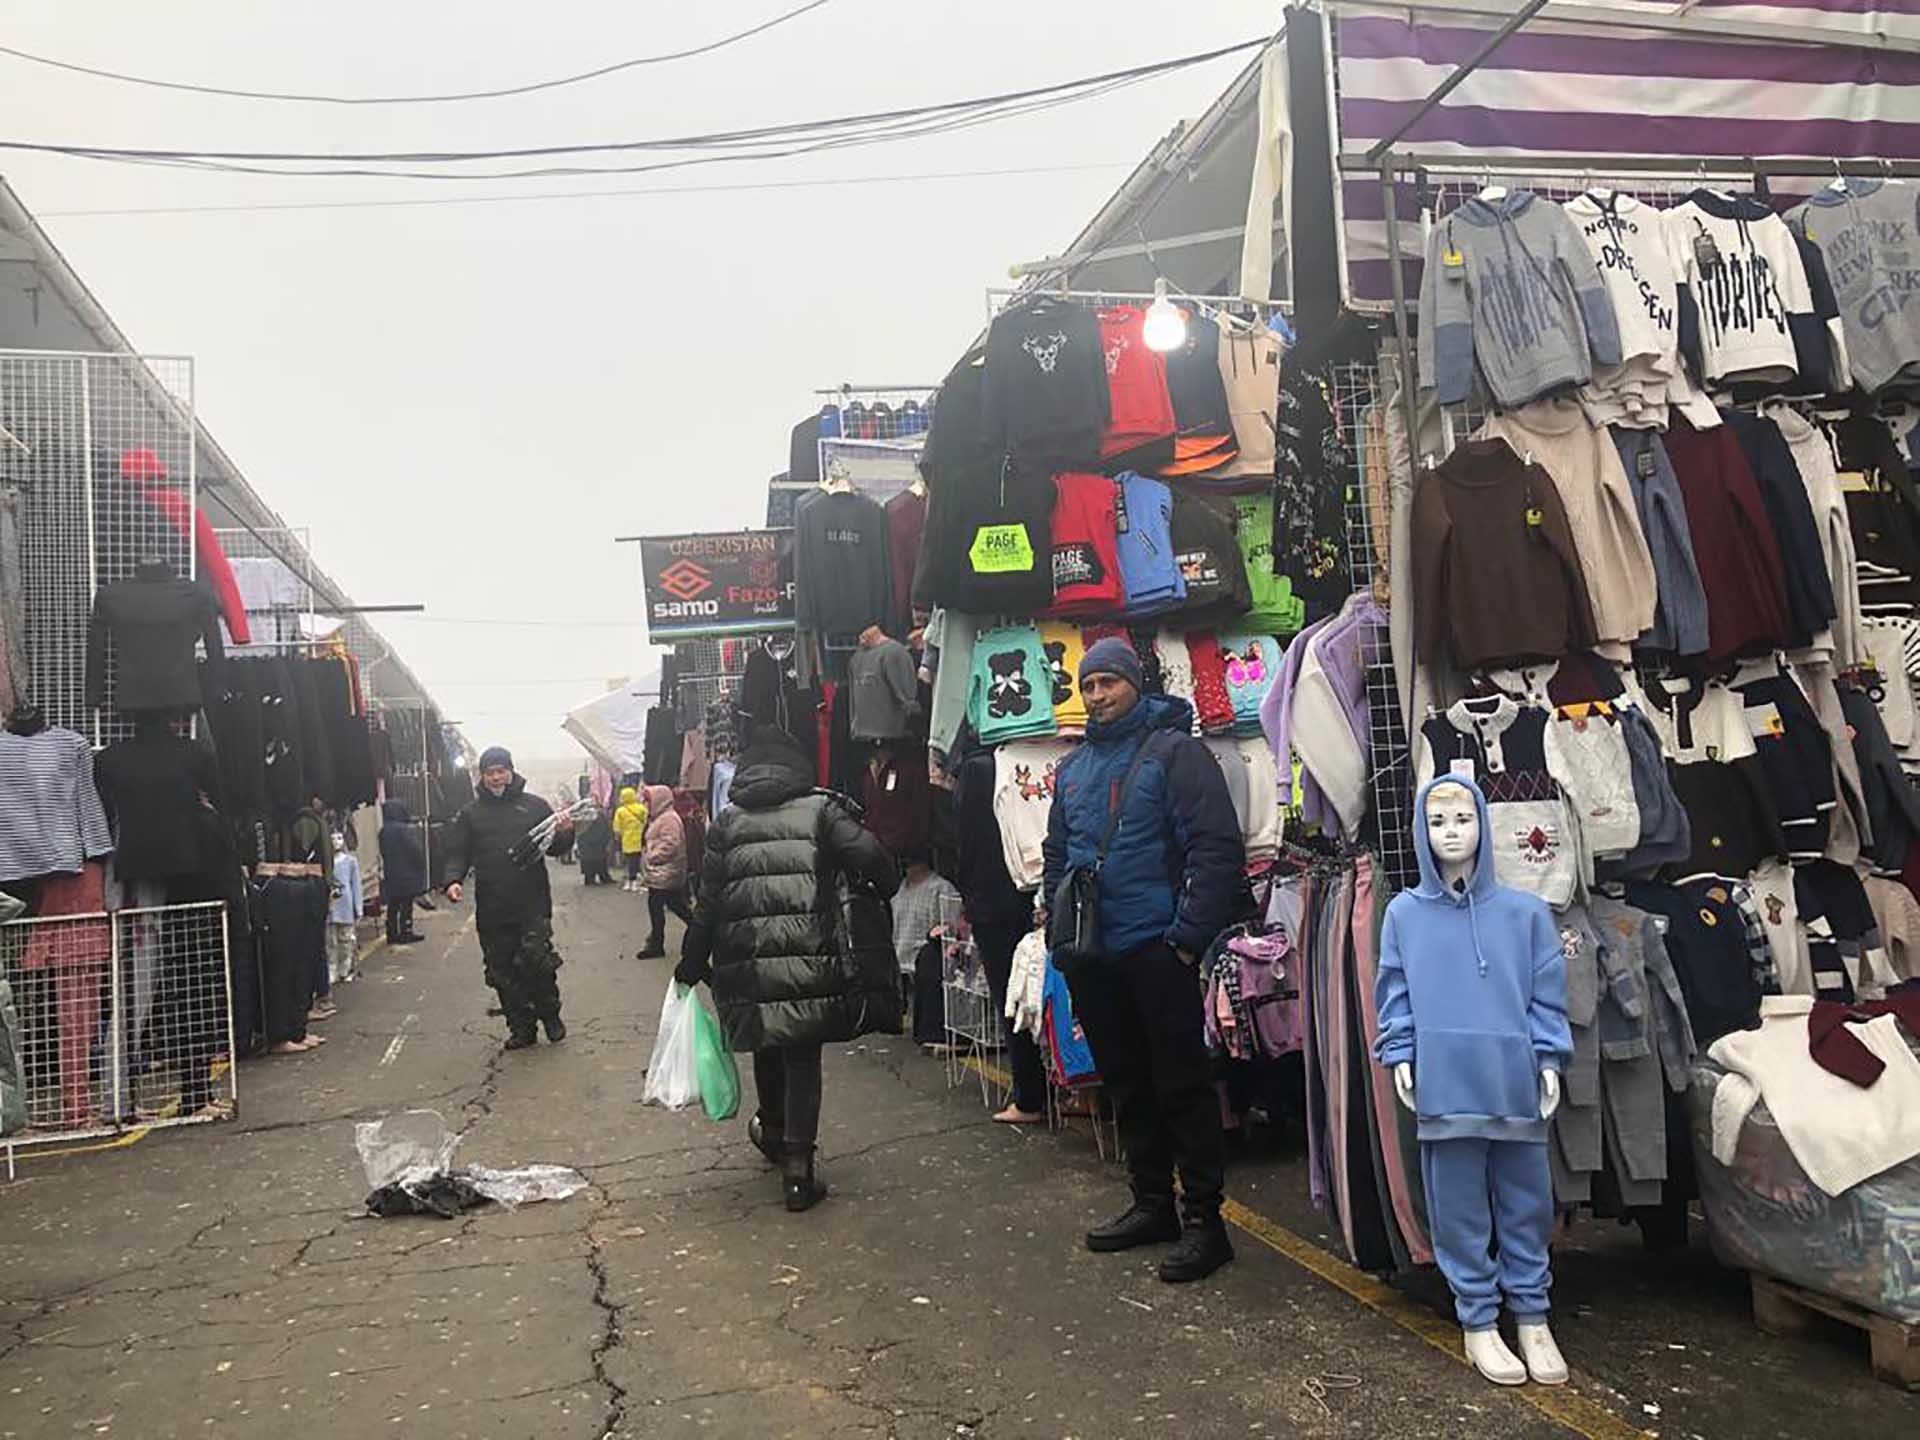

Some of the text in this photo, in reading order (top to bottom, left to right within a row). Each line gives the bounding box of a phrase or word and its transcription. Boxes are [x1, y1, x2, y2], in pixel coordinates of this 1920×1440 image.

[669, 535, 776, 555] UZBEKISTAN
[986, 533, 1018, 548] PAGE
[653, 599, 719, 618] samo
